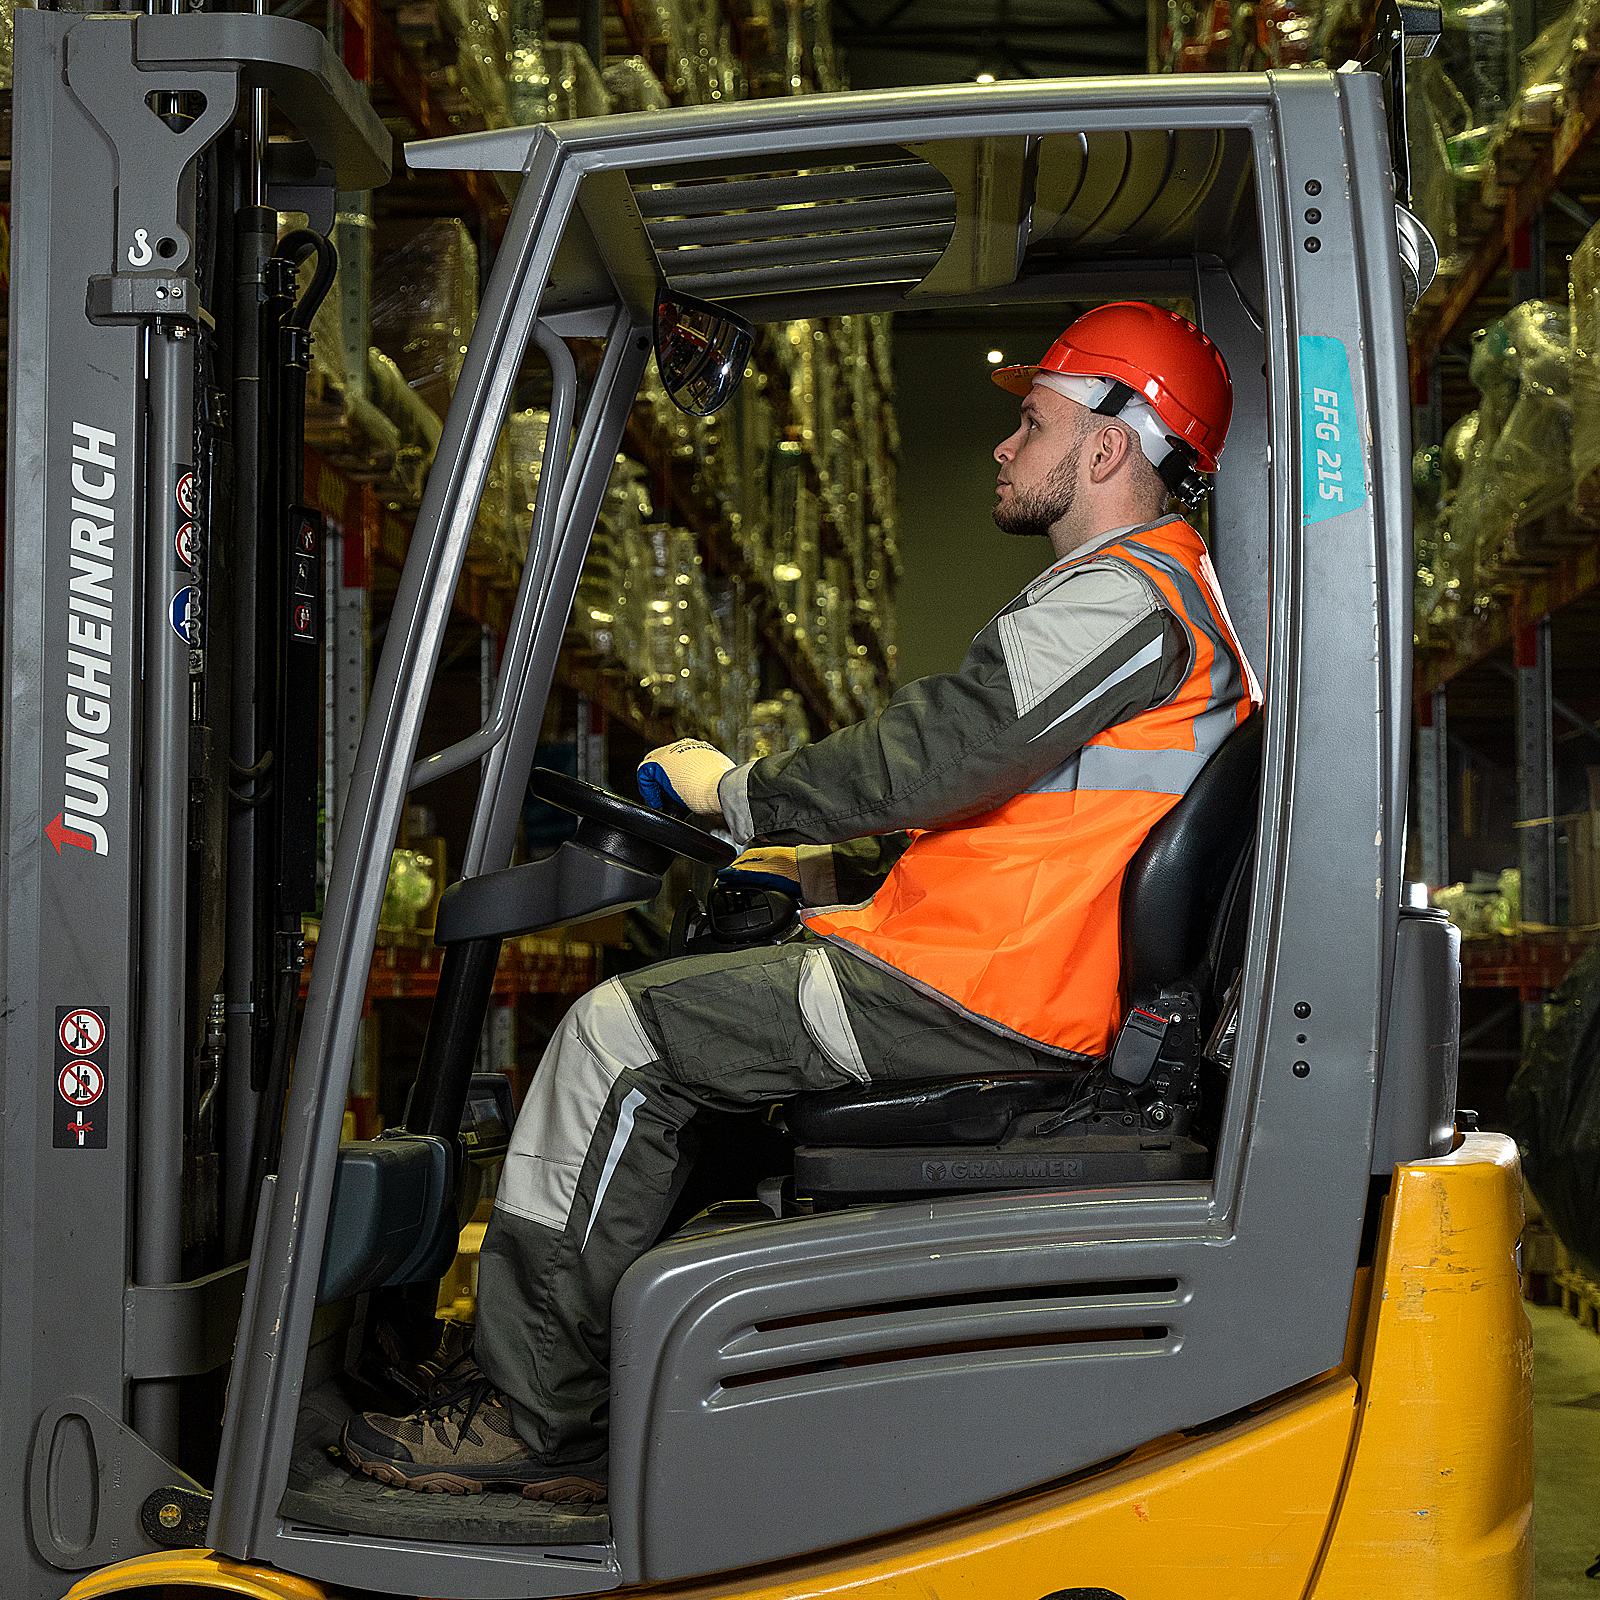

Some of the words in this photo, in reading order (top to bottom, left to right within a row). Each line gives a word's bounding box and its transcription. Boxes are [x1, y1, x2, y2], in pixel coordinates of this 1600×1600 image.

[1313, 387, 1340, 442] EFG
[1316, 448, 1344, 502] 215
[64, 421, 116, 857] JUNGHEINRICH
[951, 1161, 1078, 1179] GRAMMER
